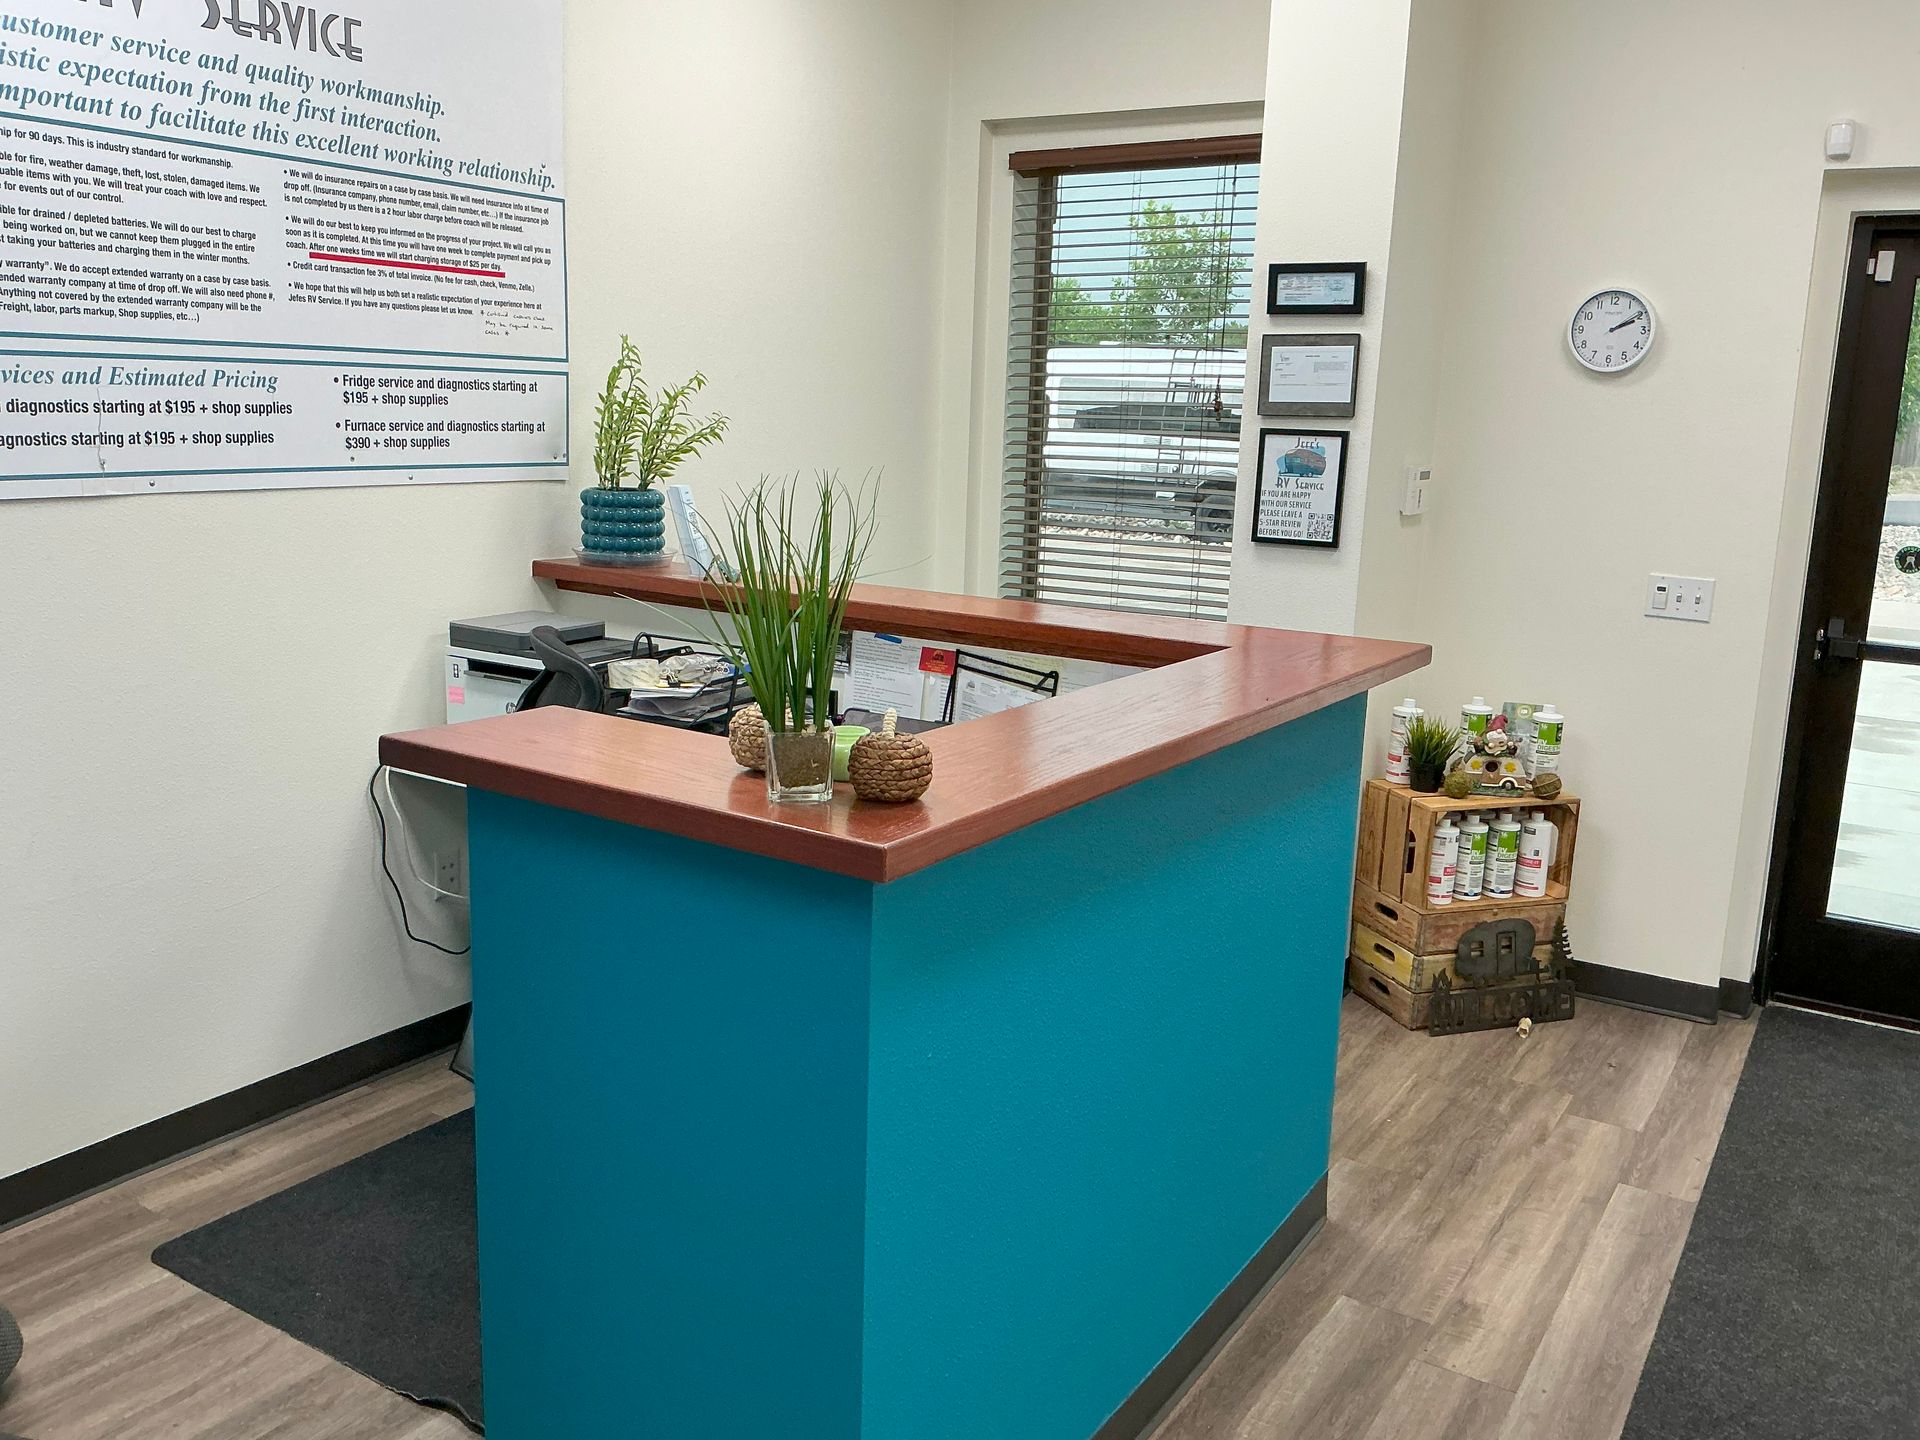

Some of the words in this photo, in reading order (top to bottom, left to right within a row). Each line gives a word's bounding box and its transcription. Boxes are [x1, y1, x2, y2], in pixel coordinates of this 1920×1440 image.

[0, 15, 104, 46] ustomer
[110, 36, 190, 64] service
[197, 53, 239, 74] and
[244, 63, 314, 93] quality
[320, 79, 444, 118] workmanship.
[58, 60, 192, 96] expectation
[196, 80, 251, 107] from
[258, 91, 290, 114] the
[291, 97, 336, 122] first
[340, 106, 440, 141] interaction.
[13, 128, 26, 138] for
[28, 130, 39, 140] 90
[41, 132, 64, 144] days.
[66, 135, 84, 146] This
[86, 138, 94, 148] is
[95, 140, 129, 154] industry
[131, 146, 166, 158] standard
[167, 150, 179, 160] for
[180, 154, 233, 168] workmanship.
[120, 100, 148, 128] to
[146, 103, 246, 136] facilitate
[252, 120, 289, 144] this
[295, 134, 379, 158] excellent
[383, 148, 453, 177] working
[458, 158, 555, 192] relationship.
[3, 219, 27, 232] being
[29, 223, 62, 233] worked
[64, 227, 77, 236] on,
[78, 226, 93, 236] but
[94, 230, 107, 238] we
[109, 231, 137, 240] cannot
[138, 232, 158, 244] keep
[159, 234, 179, 244] them
[180, 237, 210, 248] plugged
[212, 239, 219, 248] in
[221, 241, 233, 250] the
[234, 243, 255, 252] entire
[285, 241, 308, 249] coach.
[308, 242, 325, 251] After
[339, 246, 359, 254] weeks
[360, 247, 375, 256] time
[386, 251, 397, 259] will
[398, 252, 412, 260] start
[413, 254, 439, 263] charging
[439, 257, 461, 266] storage
[468, 259, 479, 268] $25
[1597, 300, 1603, 309] 11
[1611, 296, 1620, 305] 12
[33, 303, 57, 314] labor,
[59, 305, 81, 315] parts
[83, 307, 116, 317] markup,
[118, 308, 138, 319] Shop
[140, 310, 174, 320] supplies,
[1584, 311, 1593, 320] 10
[1637, 311, 1643, 320] 2
[1578, 325, 1584, 334] 9
[1640, 326, 1646, 335] 3
[1580, 340, 1587, 349] 8
[1634, 341, 1639, 349] 4
[1605, 355, 1611, 363] 6
[1621, 351, 1627, 360] 5
[61, 366, 102, 384] and
[108, 366, 206, 386] Estimated
[211, 369, 278, 393] Pricing
[342, 374, 375, 392] Fridge
[377, 376, 414, 388] service
[416, 377, 434, 388] and
[436, 377, 490, 391] diagnostics
[492, 380, 526, 394] starting
[528, 381, 537, 392] at
[342, 390, 368, 403] $195
[370, 395, 378, 403] +
[381, 392, 405, 406] shop
[408, 393, 448, 407] supplies
[5, 398, 88, 415] diagnostics
[92, 399, 144, 416] starting
[148, 400, 162, 413] at
[164, 399, 195, 414] $195
[199, 403, 208, 413] +
[211, 400, 240, 416] shop
[244, 401, 292, 416] supplies
[344, 419, 386, 431] Furnace
[388, 420, 424, 431] service
[426, 420, 444, 432] and
[446, 420, 498, 433] diagnostics
[500, 421, 534, 433] starting
[536, 421, 545, 431] at
[70, 431, 124, 447] starting
[128, 431, 141, 444] at
[143, 430, 175, 445] $195
[179, 434, 188, 443] +
[191, 430, 221, 446] shop
[224, 430, 274, 445] supplies
[345, 436, 370, 449] $390
[373, 438, 380, 447] +
[383, 436, 407, 449] shop
[409, 435, 450, 449] supplies
[1275, 477, 1290, 488] RV
